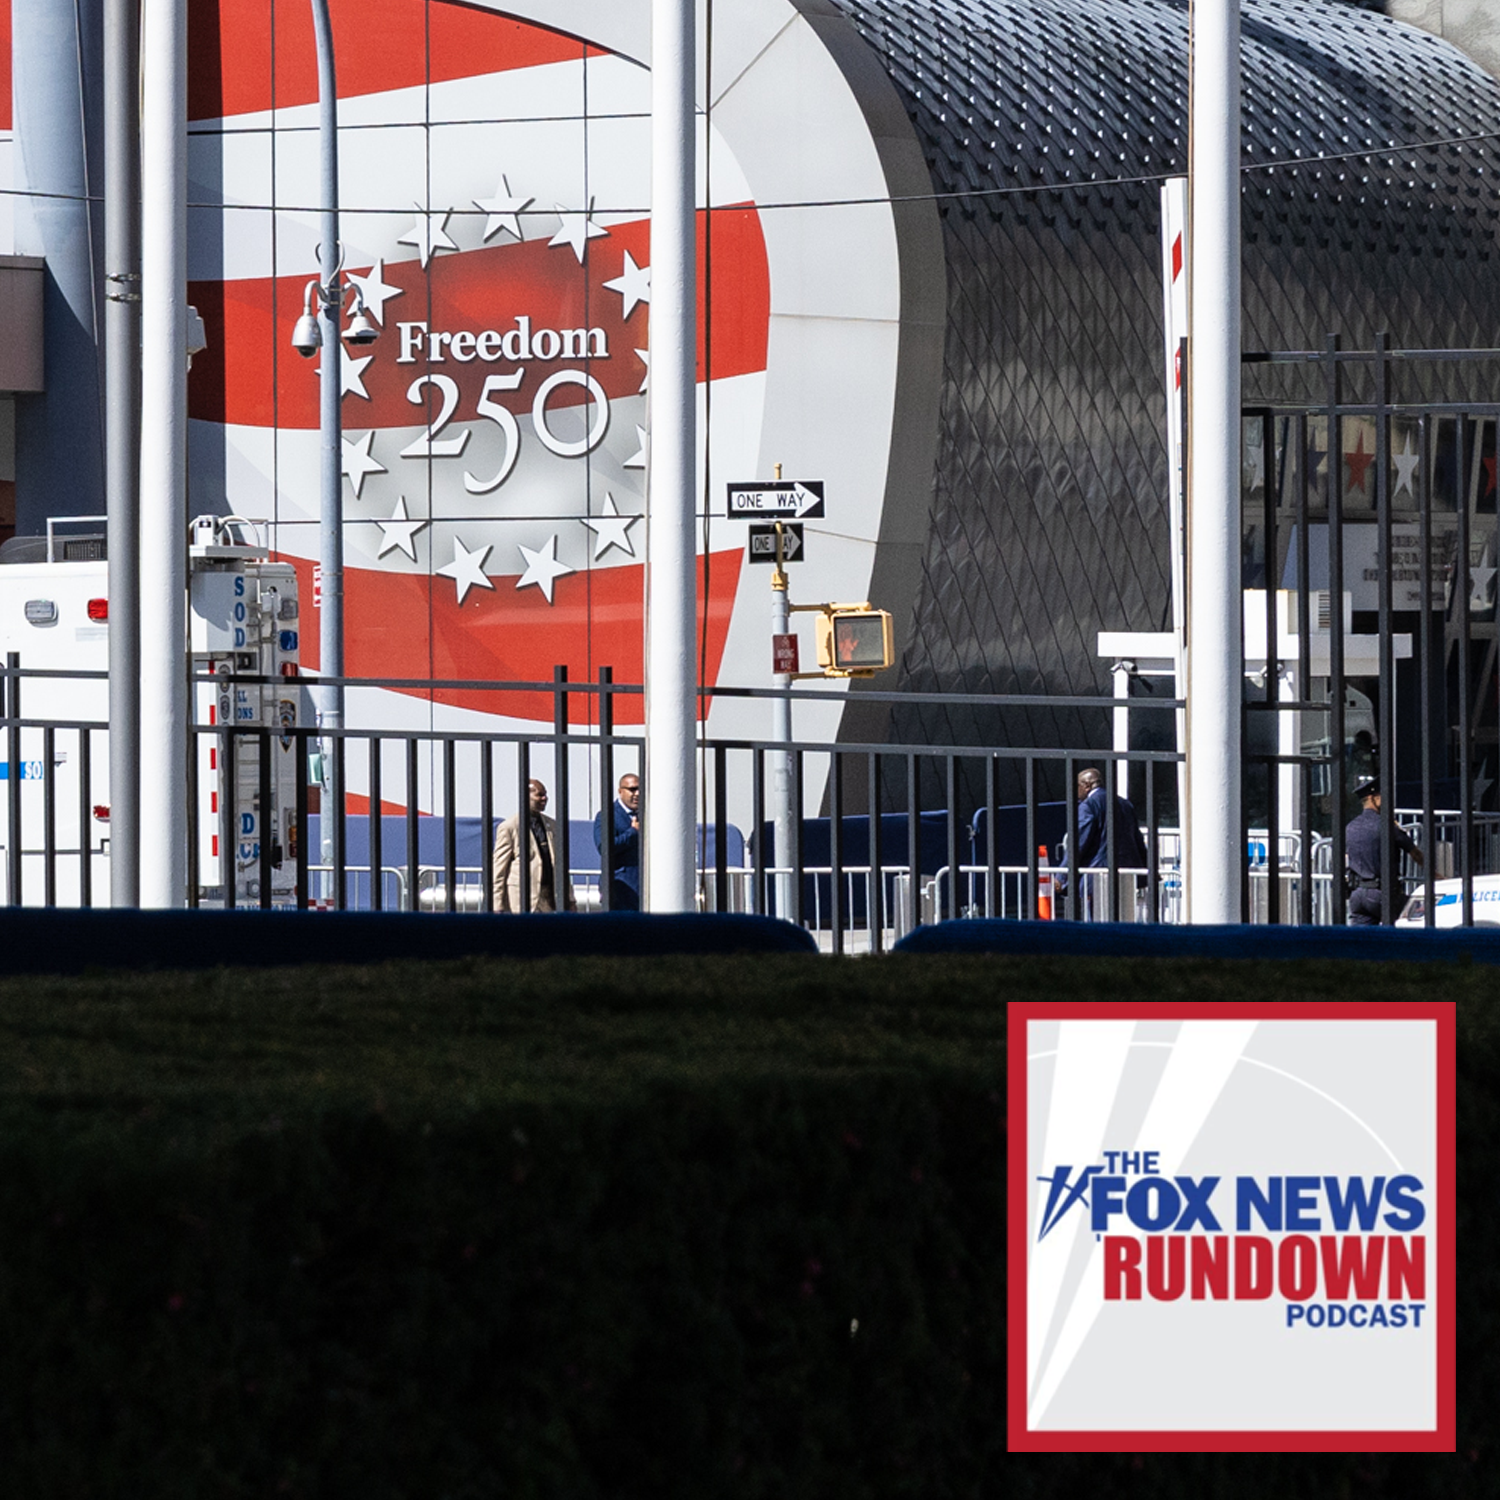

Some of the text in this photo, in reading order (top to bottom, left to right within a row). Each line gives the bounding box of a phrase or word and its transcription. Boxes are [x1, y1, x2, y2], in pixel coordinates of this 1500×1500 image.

[396, 315, 609, 364] Freedom
[399, 366, 610, 496] 250
[737, 491, 806, 509] ONE WAY
[754, 536, 771, 551] ONE
